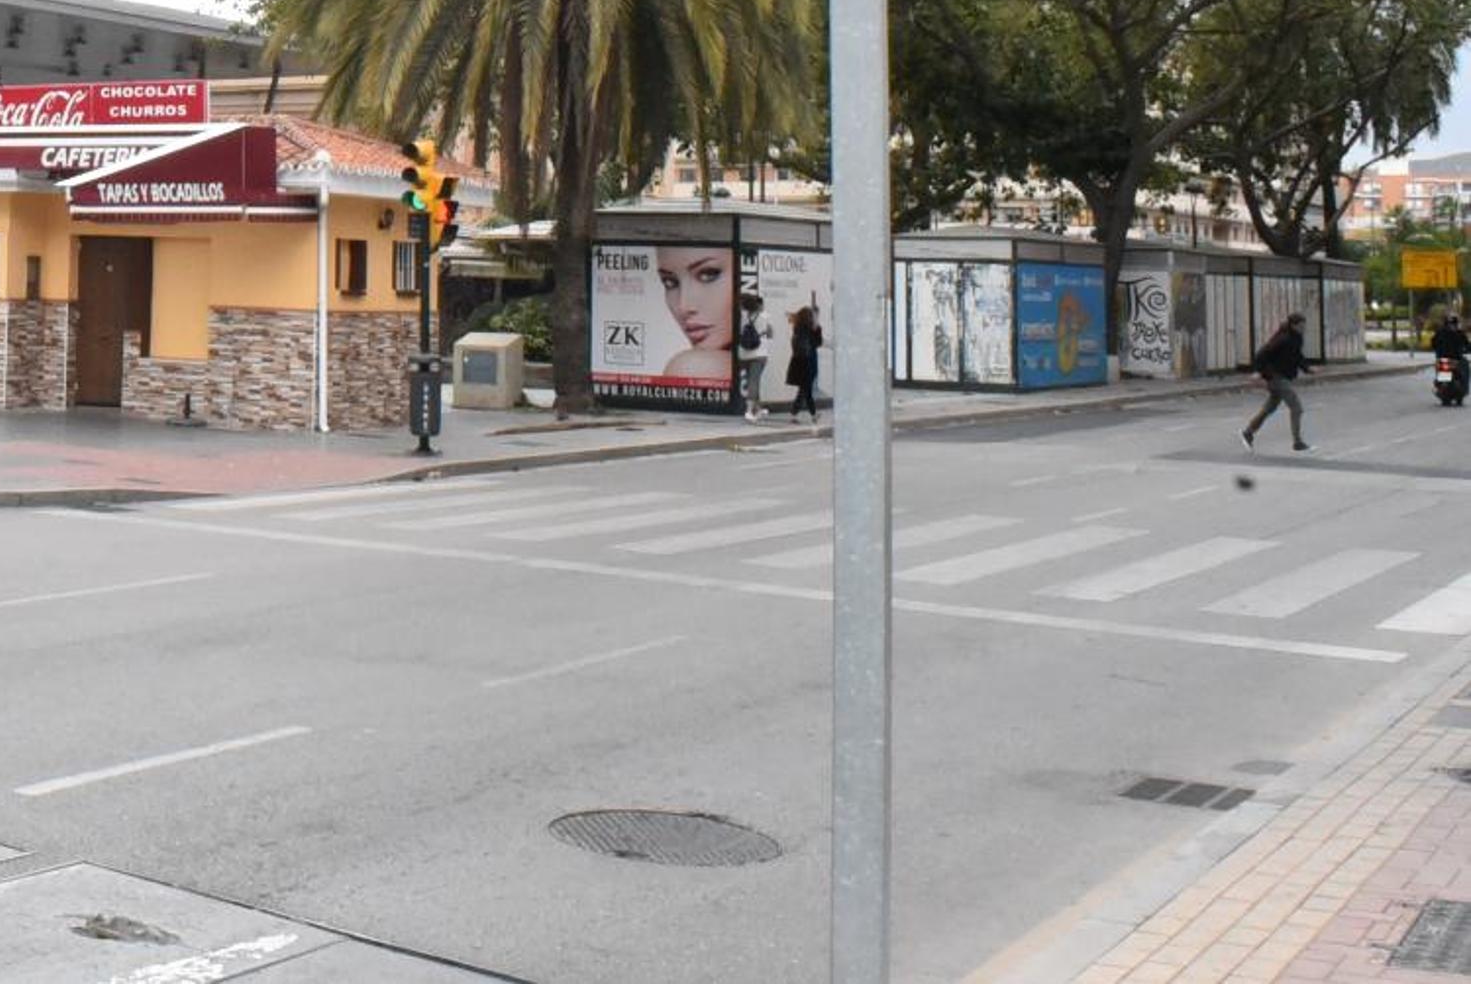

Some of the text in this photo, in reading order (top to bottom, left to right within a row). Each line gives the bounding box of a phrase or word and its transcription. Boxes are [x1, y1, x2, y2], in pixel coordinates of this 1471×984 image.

[100, 84, 198, 98] CHOCOLATE
[109, 104, 188, 117] CHURROS
[40, 147, 150, 168] CAFETER
[97, 181, 225, 203] TAPAS Y BOCADILLOS
[597, 254, 649, 271] PEELING
[607, 325, 640, 346] ZK
